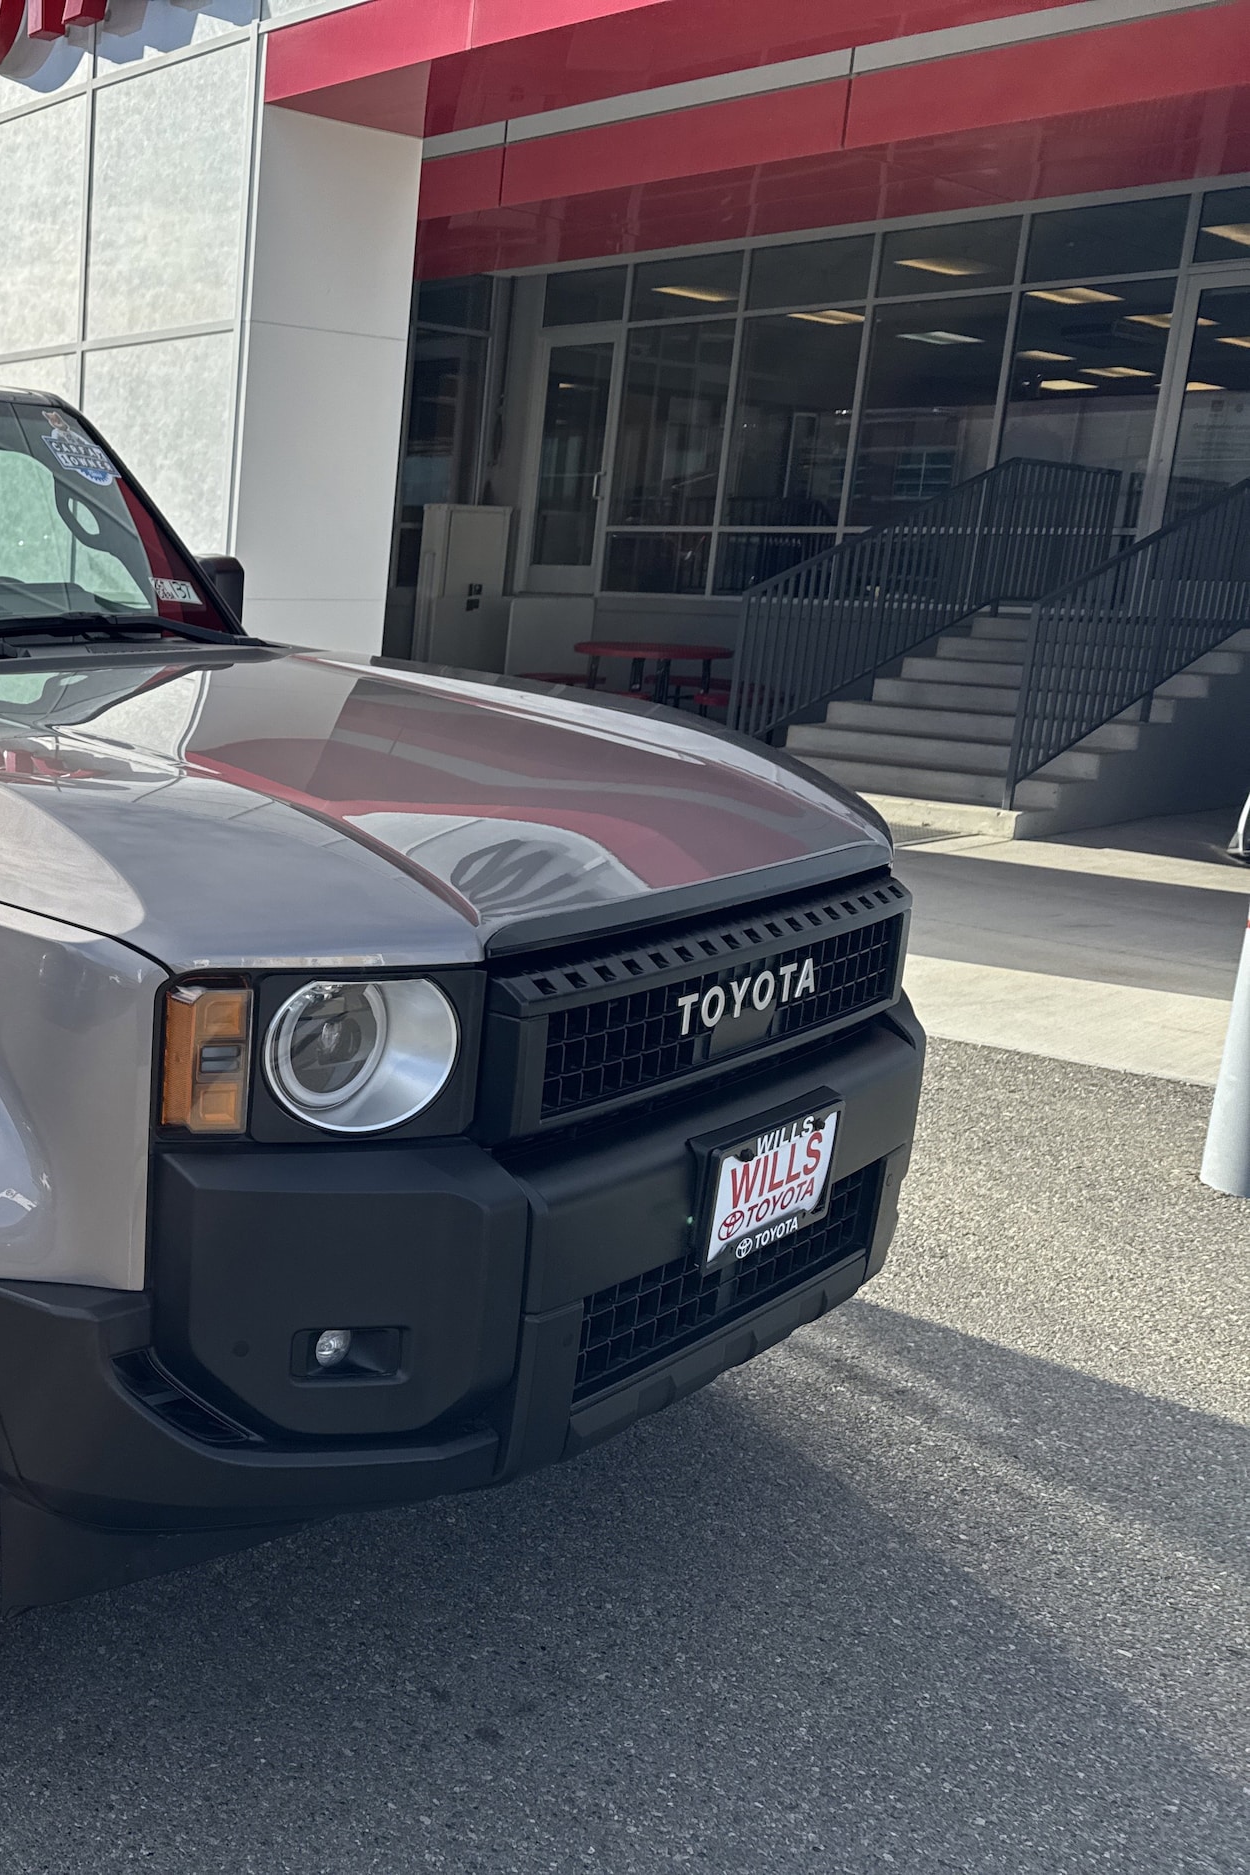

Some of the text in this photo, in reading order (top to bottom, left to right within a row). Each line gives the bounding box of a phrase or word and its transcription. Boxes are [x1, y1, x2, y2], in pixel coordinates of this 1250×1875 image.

[678, 957, 815, 1036] TOYOTA
[756, 1115, 815, 1155] WILLS
[730, 1131, 823, 1209] WILLS
[746, 1177, 815, 1228] TOYOTA
[754, 1216, 799, 1250] TOYOTA
